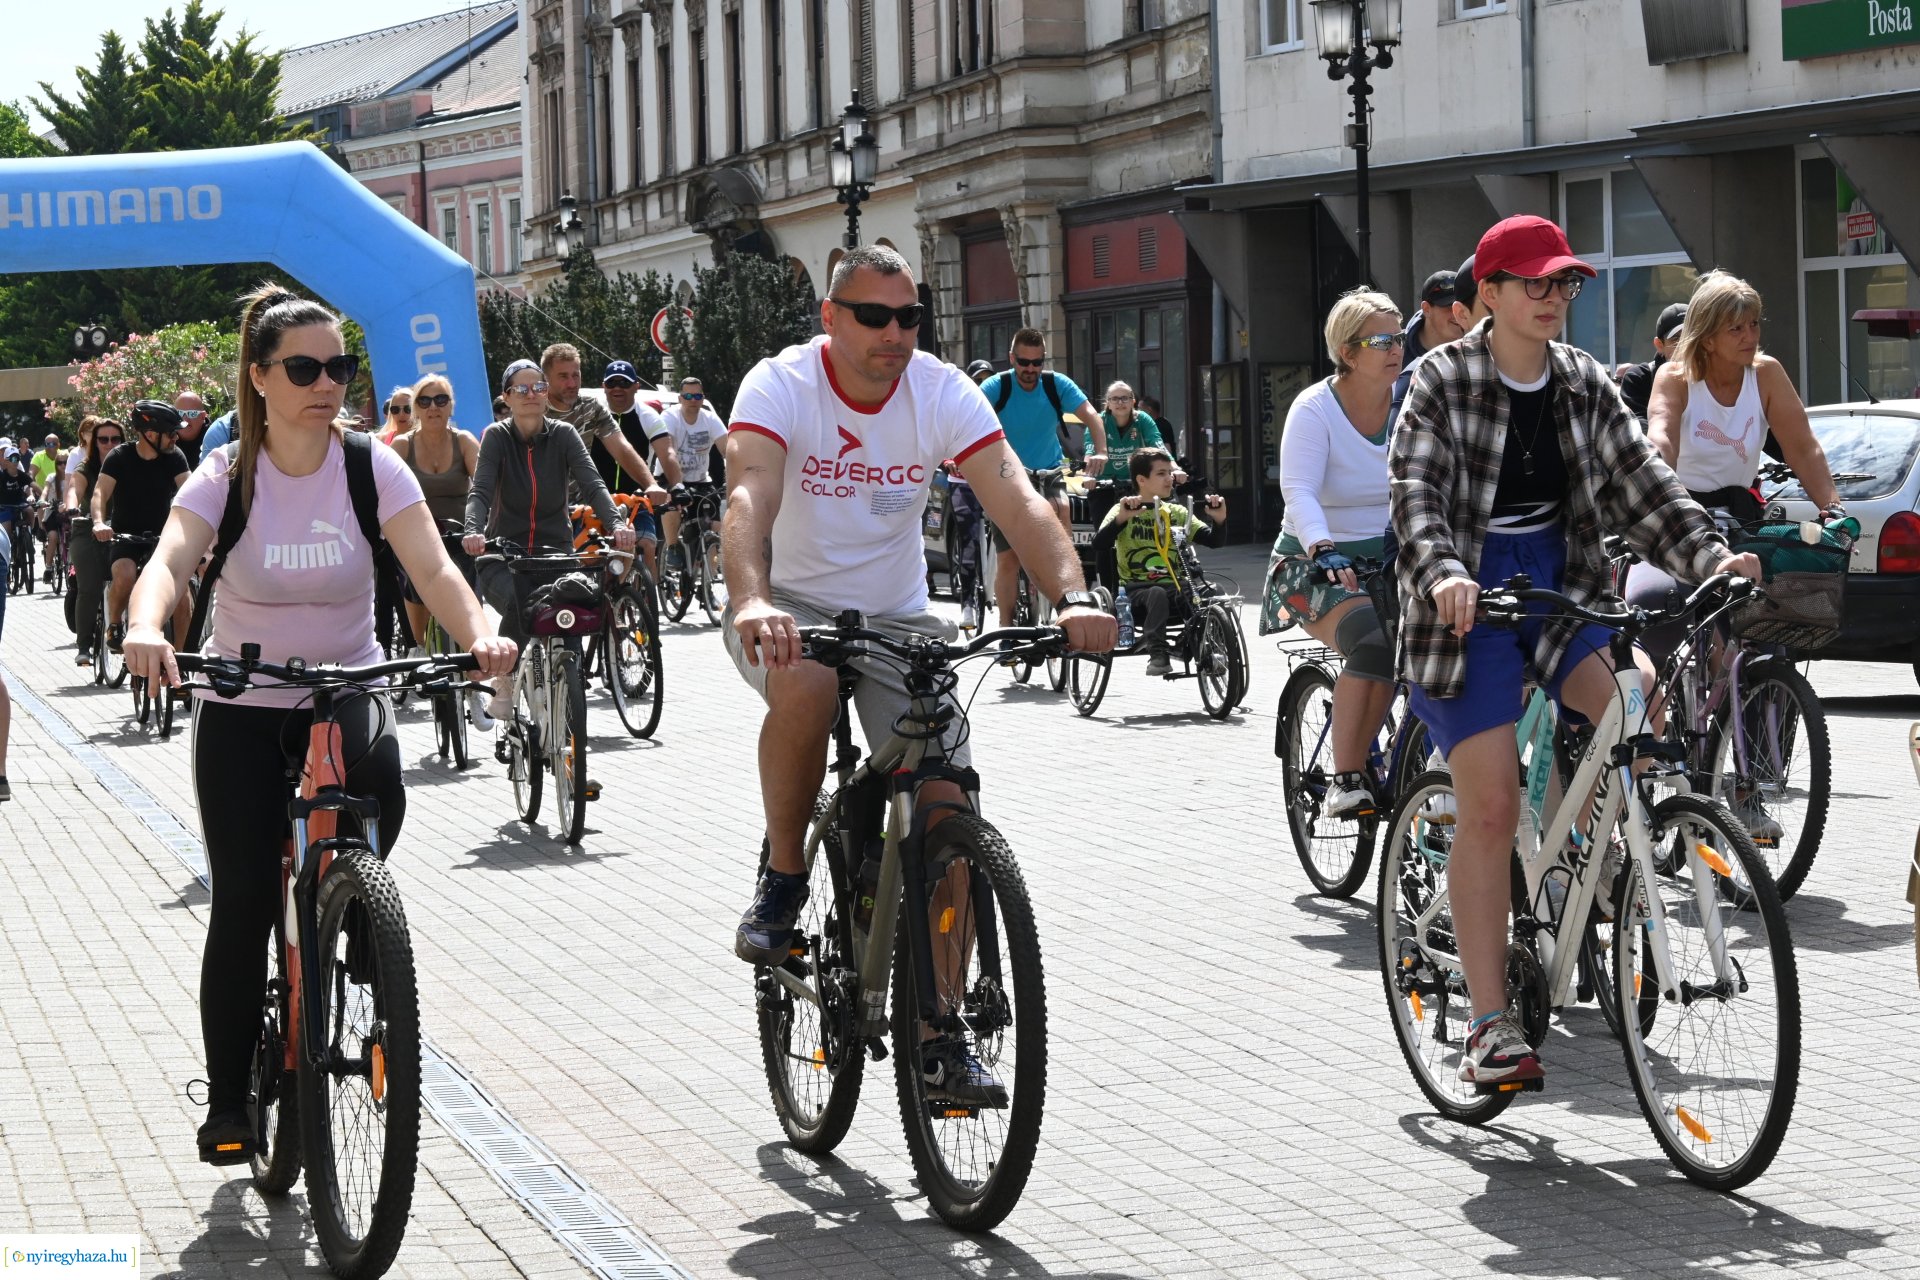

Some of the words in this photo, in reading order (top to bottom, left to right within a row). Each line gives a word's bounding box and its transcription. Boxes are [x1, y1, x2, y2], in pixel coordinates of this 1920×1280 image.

[1868, 0, 1913, 36] Posta
[801, 479, 857, 498] COLOR
[263, 540, 344, 570] PUMA
[1575, 761, 1616, 888] ALPINA
